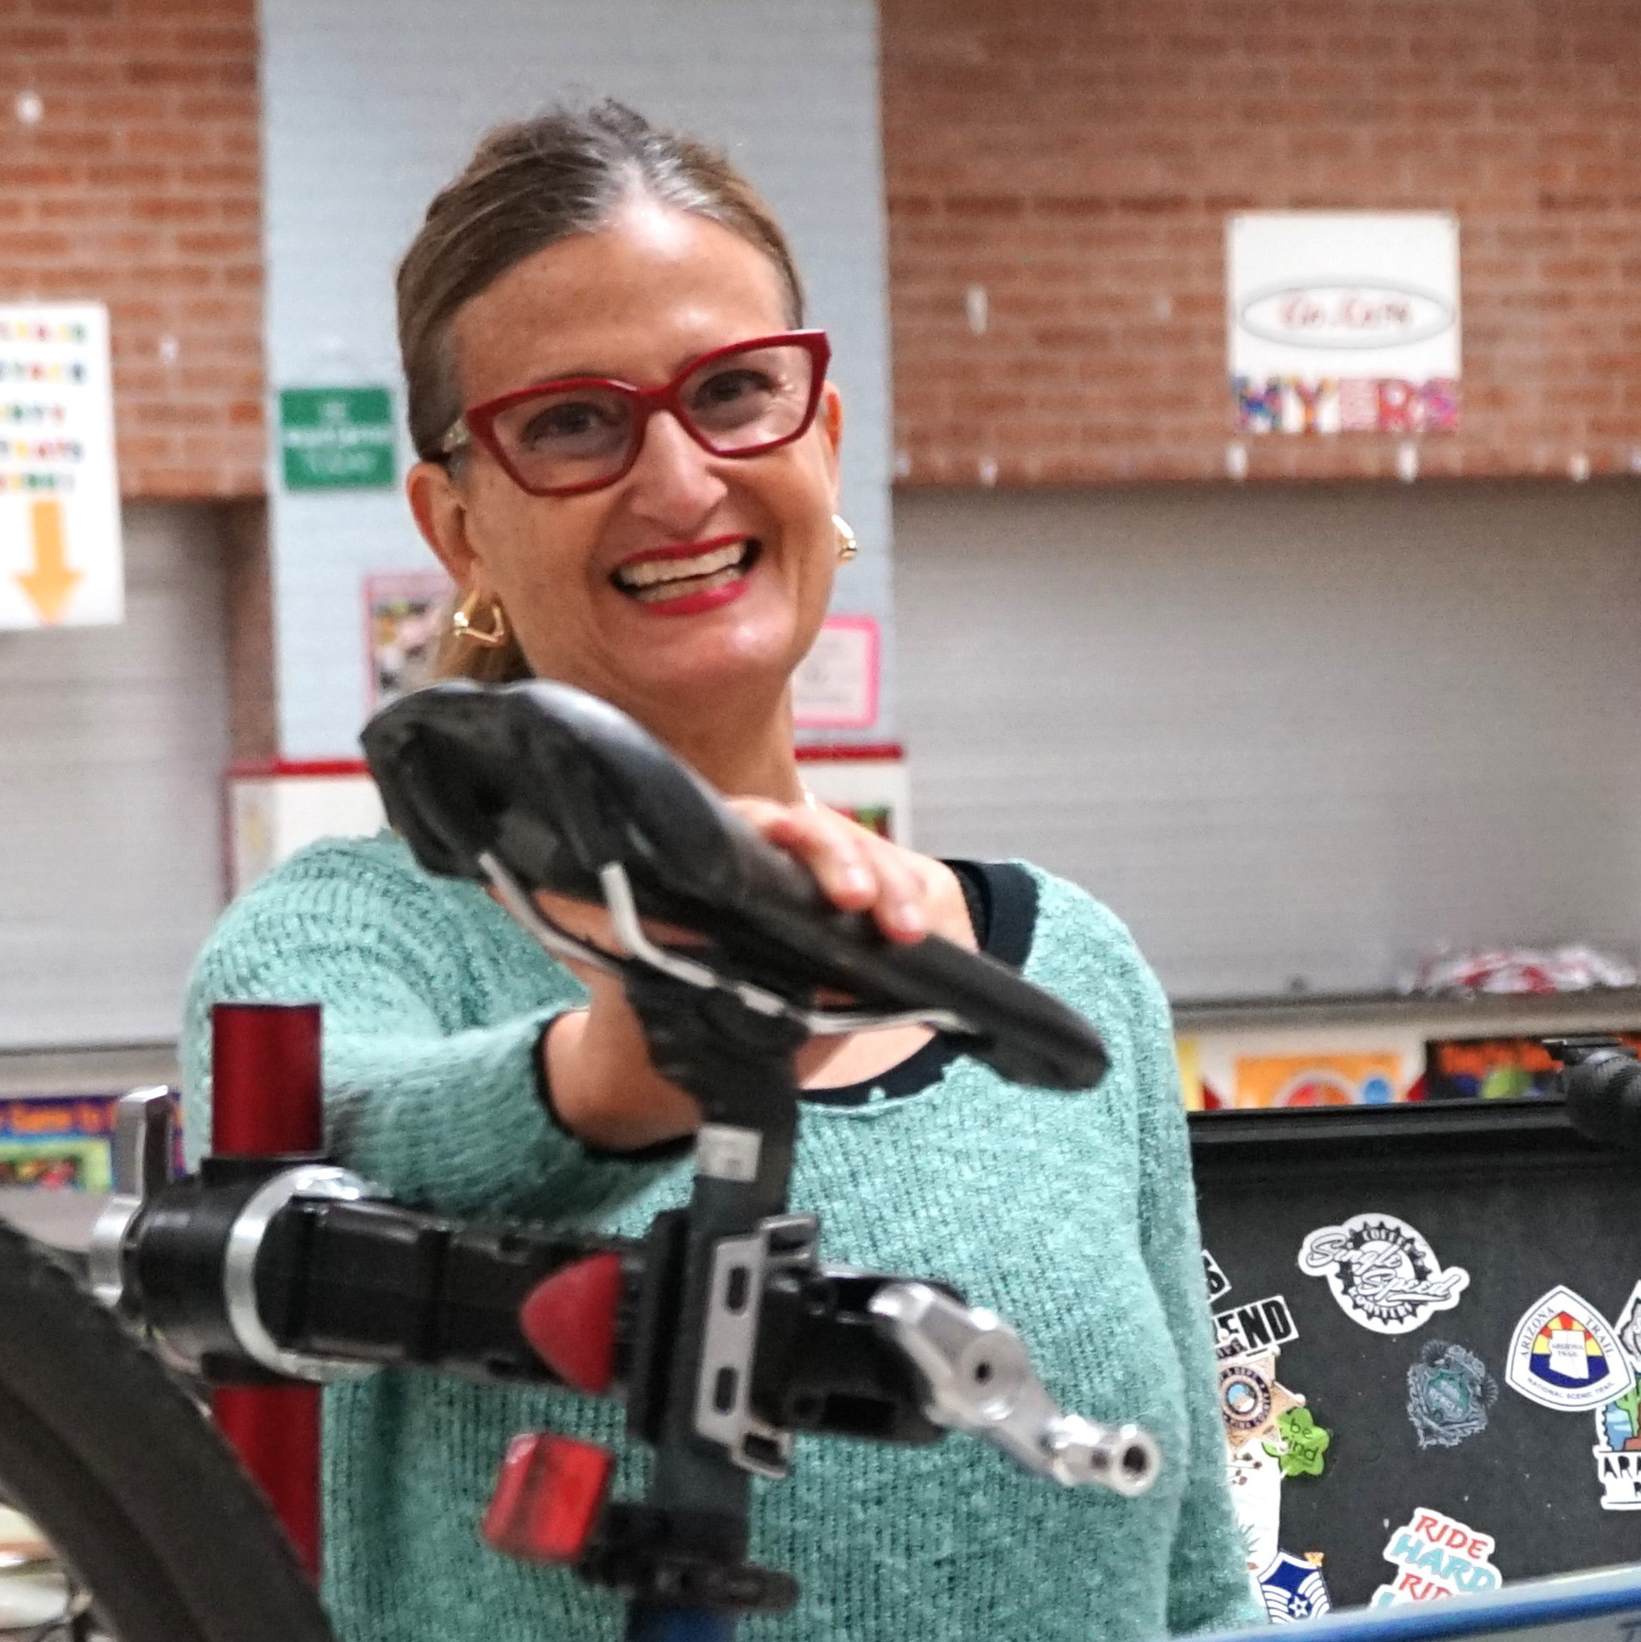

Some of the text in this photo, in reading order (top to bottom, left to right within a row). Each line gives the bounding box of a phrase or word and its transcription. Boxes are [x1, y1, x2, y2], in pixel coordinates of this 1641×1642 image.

[1305, 1232, 1403, 1276] Single
[1357, 1268, 1462, 1302] Speed
[1216, 1299, 1293, 1349] END
[1520, 1306, 1615, 1358] ARIZONA TRAIL
[1527, 1377, 1564, 1399] NATIONAL
[1566, 1390, 1593, 1400] SCENIC
[1282, 1434, 1320, 1462] ind
[1290, 1419, 1313, 1441] be
[1415, 1514, 1488, 1560] RIDE
[1390, 1532, 1496, 1593] HARD
[1399, 1572, 1455, 1601] RID
